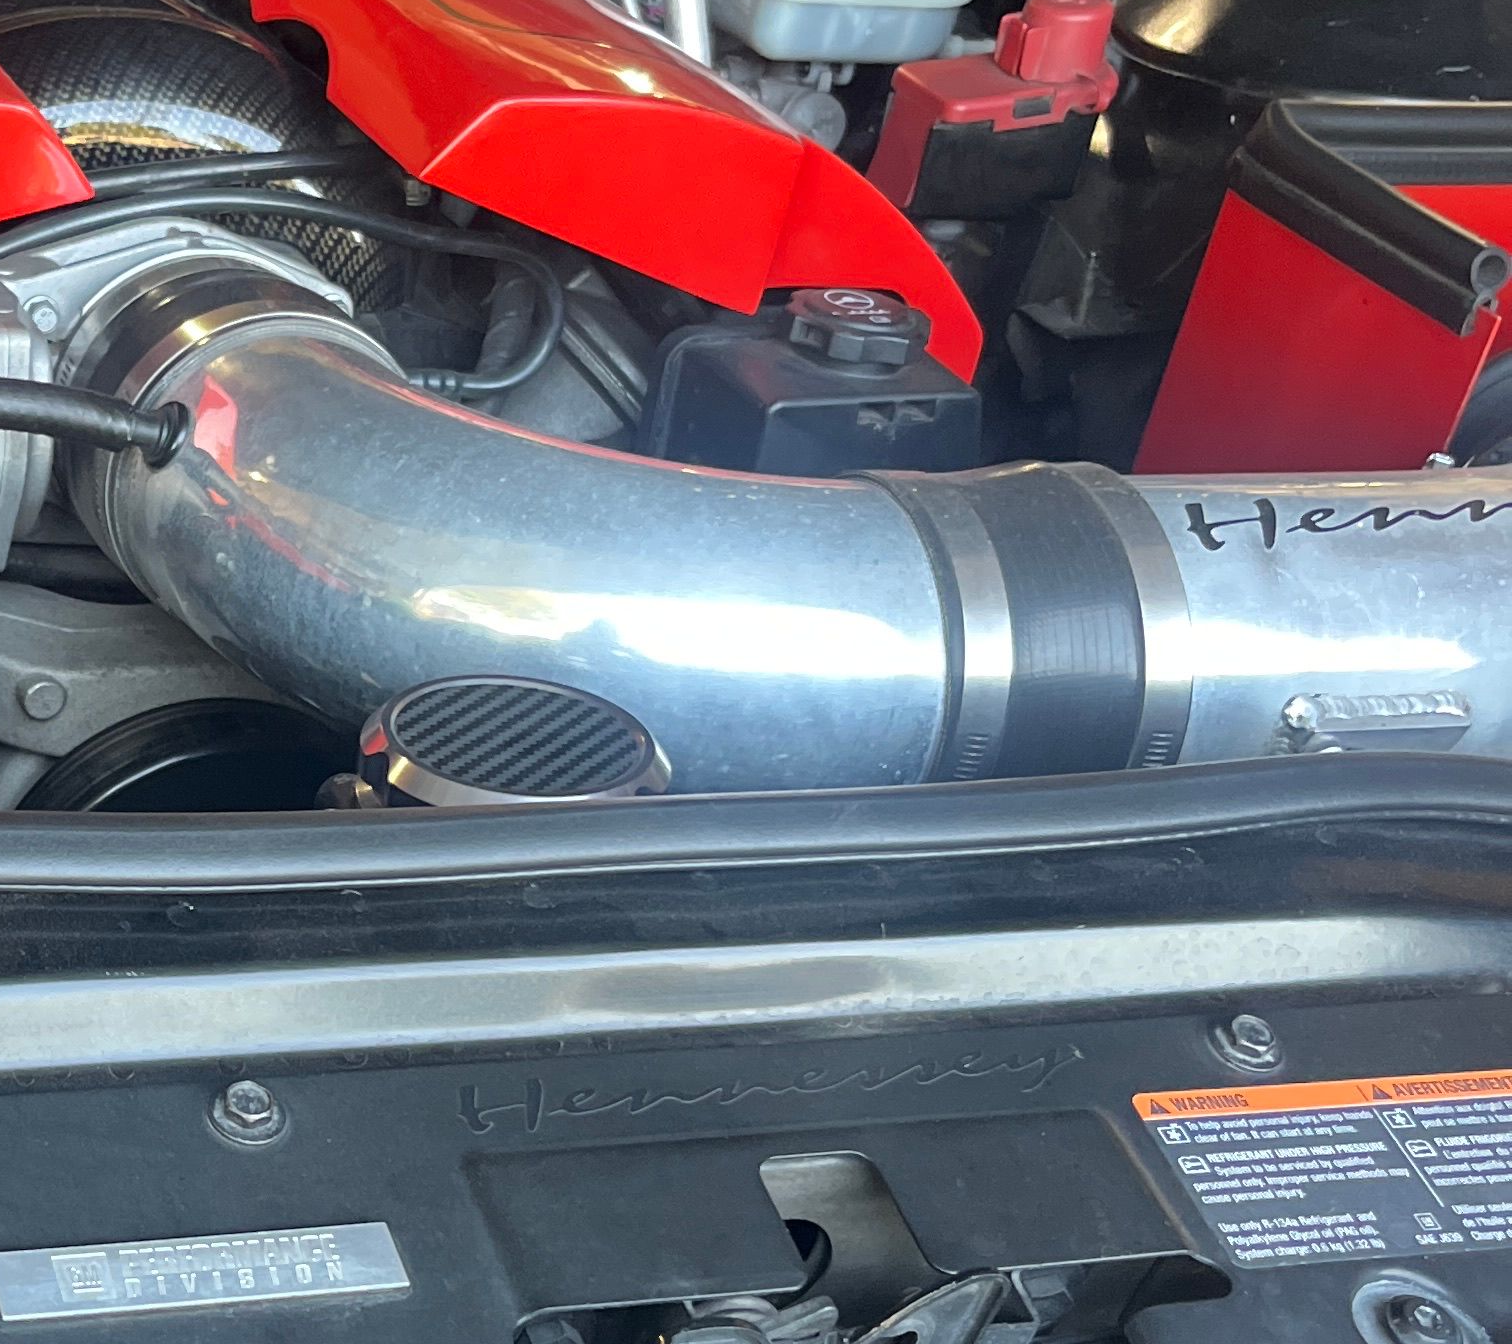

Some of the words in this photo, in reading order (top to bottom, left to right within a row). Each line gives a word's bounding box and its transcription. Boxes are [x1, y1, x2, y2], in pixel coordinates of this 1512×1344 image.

[1168, 1094, 1249, 1111] WARNING
[1185, 1121, 1199, 1131] To
[1198, 1121, 1221, 1131] help
[1222, 1118, 1249, 1129] avoid
[1248, 1116, 1290, 1129] personal
[1194, 1133, 1219, 1144] clear
[1205, 1149, 1275, 1163] REFRIGERANT
[1274, 1146, 1311, 1159] UNDER
[1309, 1145, 1336, 1156] HIGH
[1334, 1141, 1388, 1154] PRESSURE
[1214, 1165, 1252, 1177] System
[1193, 1178, 1242, 1192] personnel
[1201, 1195, 1232, 1204] cause
[1232, 1189, 1275, 1203] personal
[1217, 1222, 1240, 1233] Use
[1261, 1217, 1300, 1229] R-134a
[1298, 1213, 1355, 1226] Refrigerant
[1415, 1233, 1439, 1245] SAE
[1235, 1248, 1275, 1261] System
[123, 1260, 345, 1299] DIVISION
